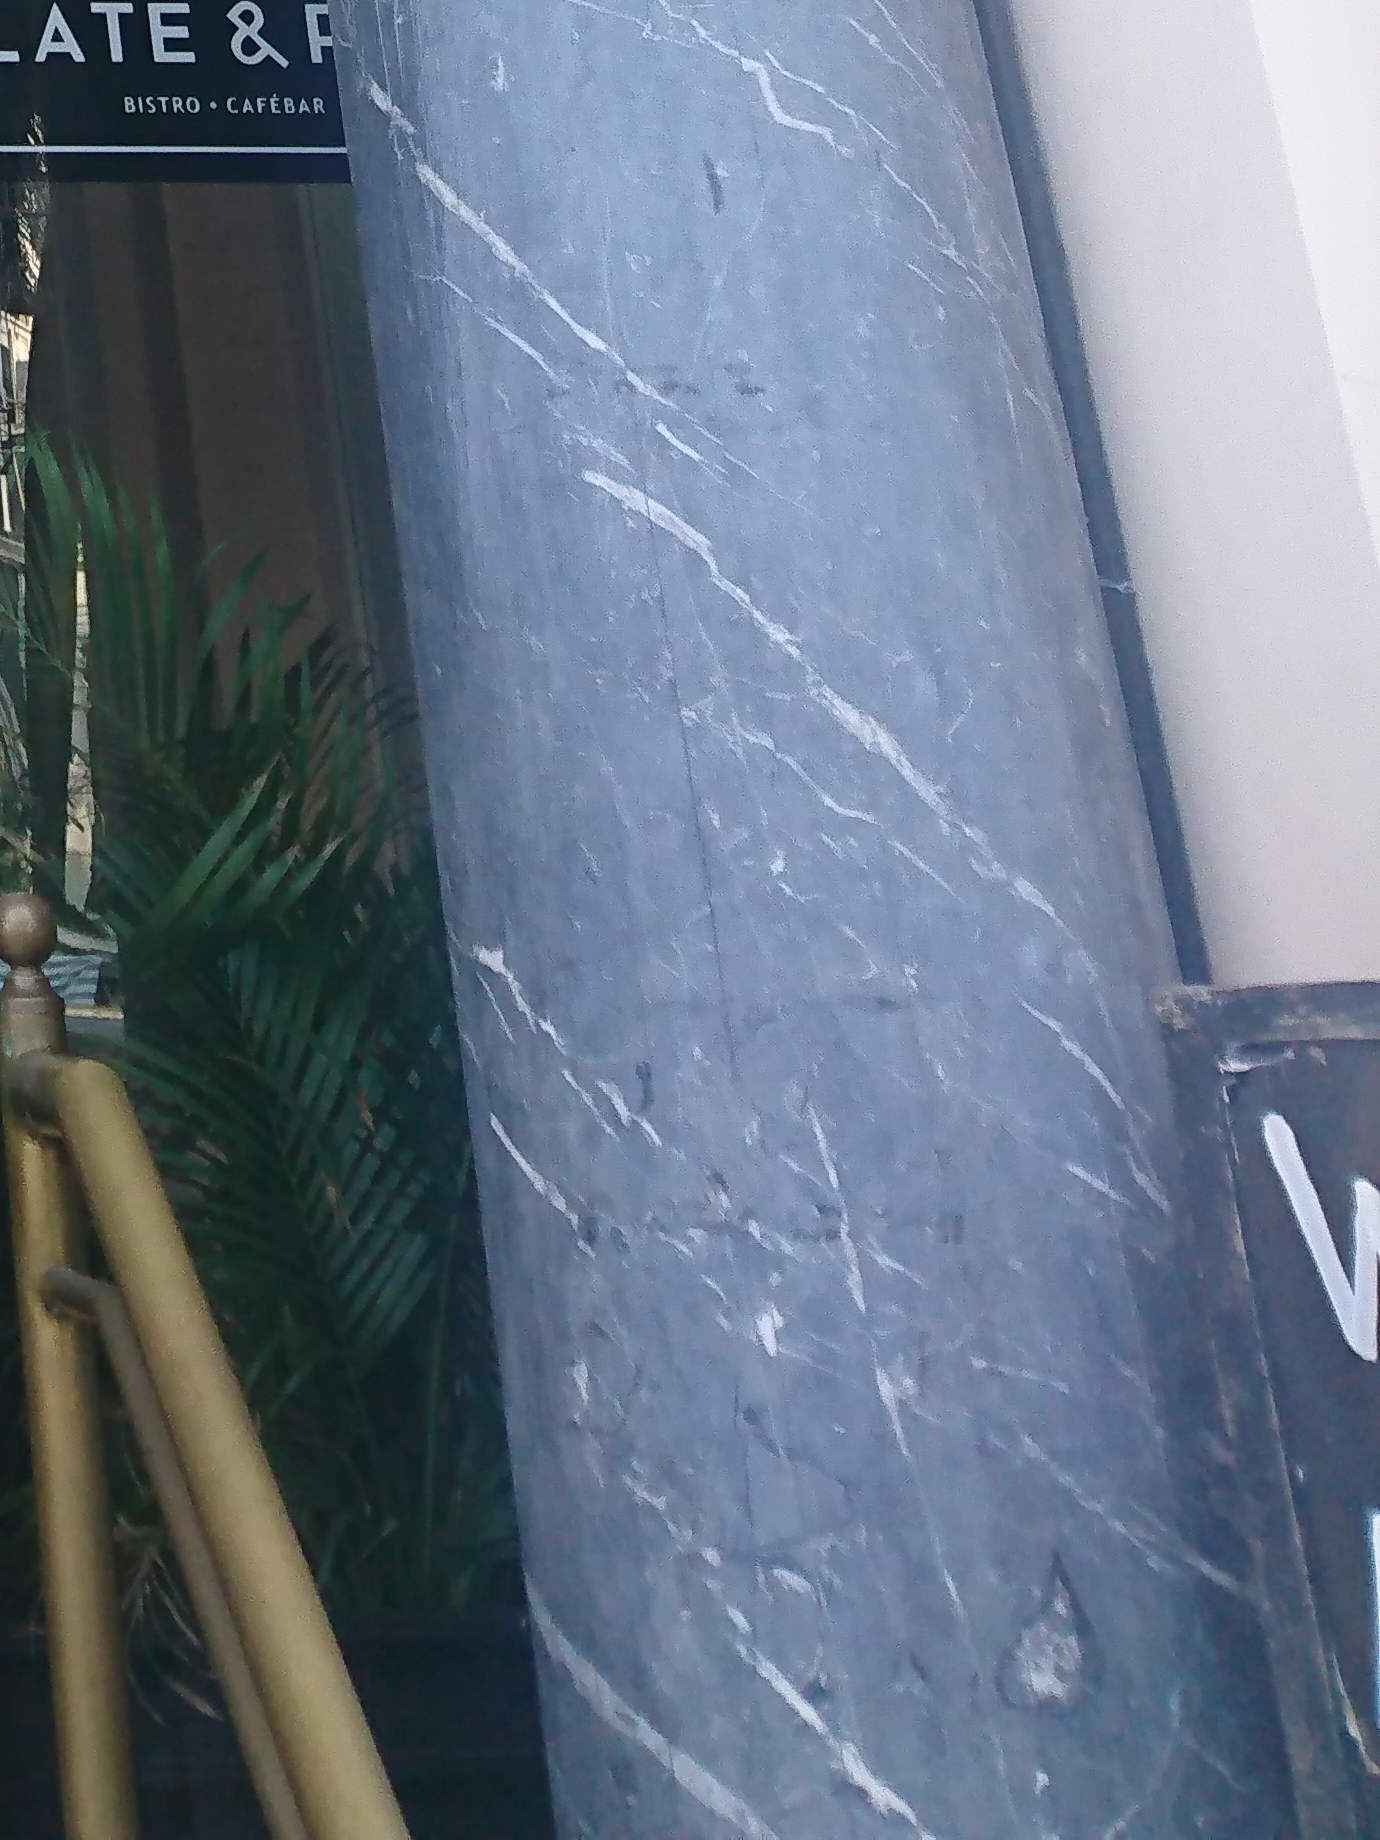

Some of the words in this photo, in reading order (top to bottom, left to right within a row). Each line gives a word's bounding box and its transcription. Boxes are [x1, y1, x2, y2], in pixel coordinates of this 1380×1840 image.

[226, 0, 290, 69] &
[123, 95, 201, 115] BISTRO
[226, 93, 326, 114] CAFÉBAR
